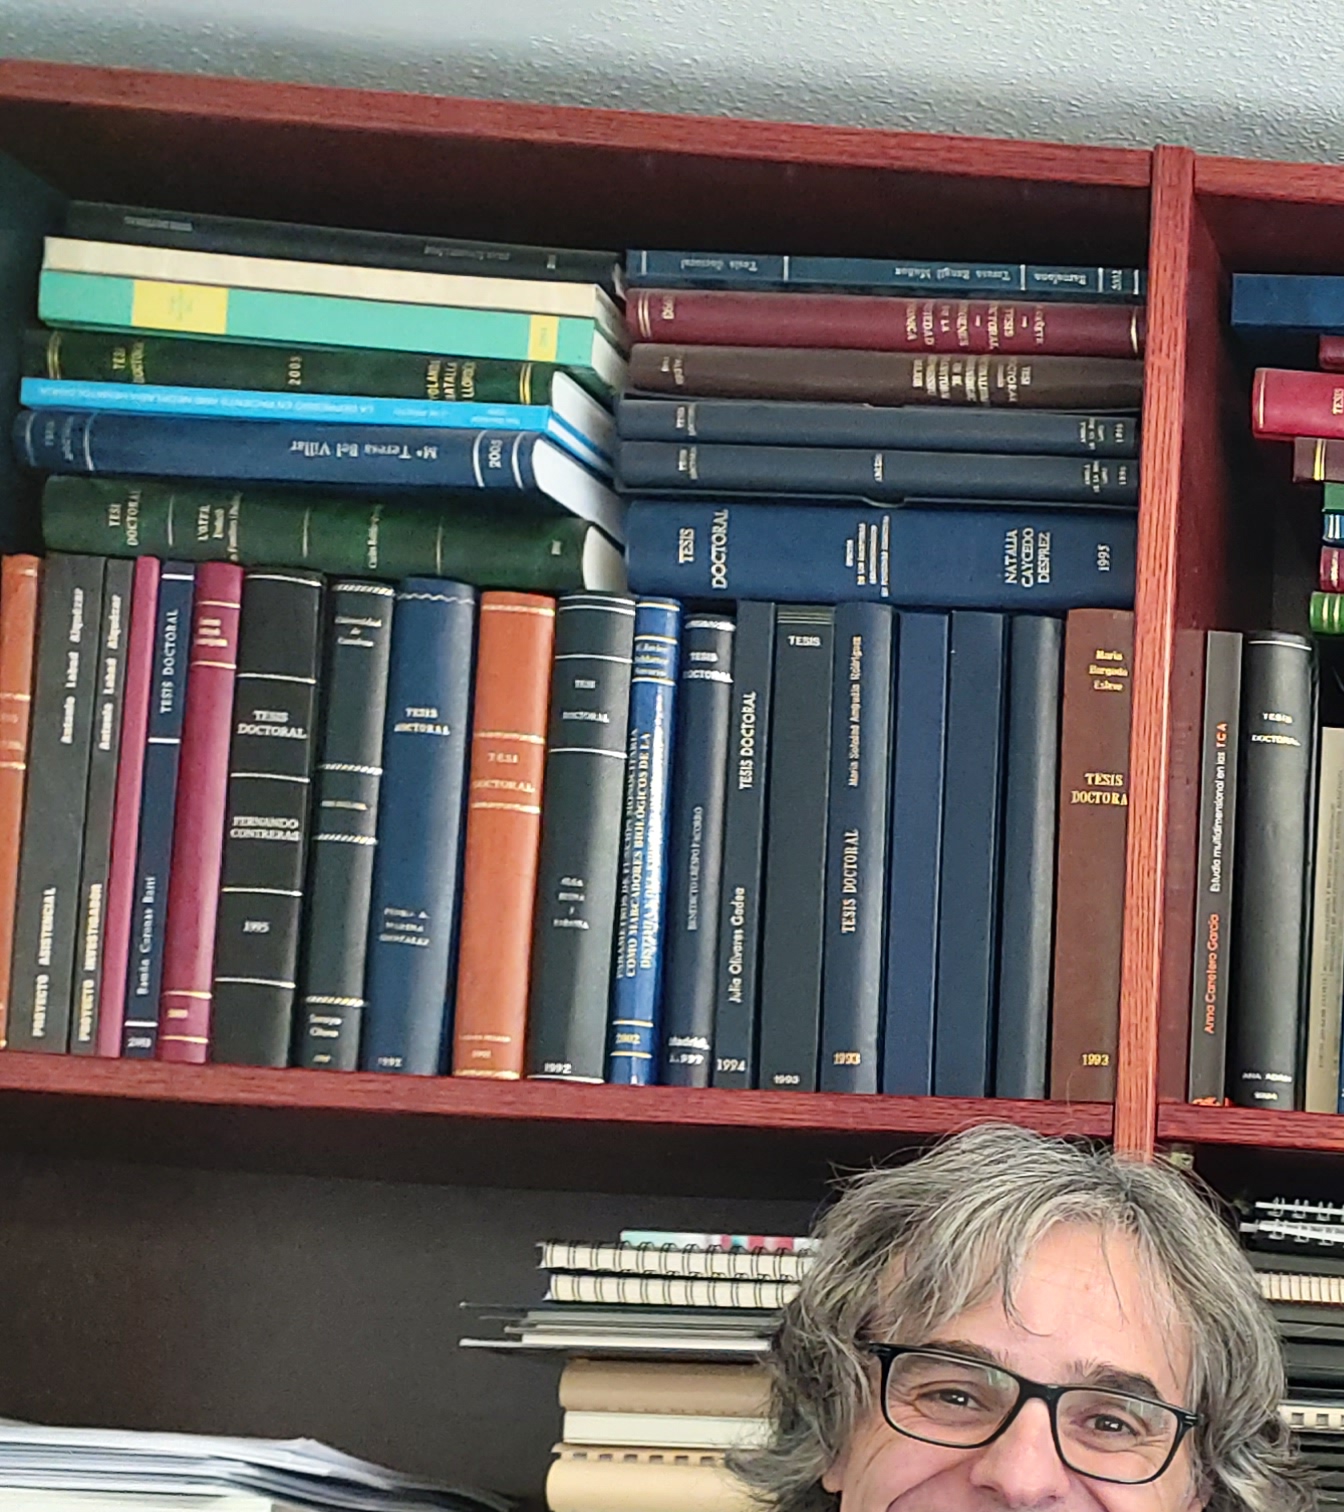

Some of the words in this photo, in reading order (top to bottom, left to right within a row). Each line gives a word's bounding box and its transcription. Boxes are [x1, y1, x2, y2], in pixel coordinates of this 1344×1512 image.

[1332, 388, 1344, 415] TESIS
[290, 440, 330, 457] Villar
[335, 442, 358, 458] Bel
[365, 443, 412, 460] Teresa
[679, 527, 695, 563] TESIS
[711, 509, 729, 589] DOCTORAL
[1005, 528, 1018, 584] NATALIA
[1020, 527, 1034, 588] CAYCEDO
[1037, 531, 1051, 584] DESPREZ
[162, 609, 179, 677] DOCTORAL
[787, 635, 821, 647] TESIS
[159, 681, 173, 714] TESIS
[237, 722, 307, 739] DOCTORAL
[252, 709, 289, 723] TESIS
[741, 691, 758, 757] DOCTORAL
[639, 732, 651, 750] LA
[638, 751, 650, 771] DE
[738, 761, 753, 791] TESIS
[1216, 766, 1226, 780] en
[1084, 772, 1124, 786] TESIS
[231, 815, 300, 829] FERNANDO
[633, 771, 649, 850] BIOLÓGICOS
[229, 828, 301, 842] CONTRERAS
[843, 829, 860, 894] DOCTORAL
[628, 851, 643, 937] MARCADORES
[841, 898, 857, 934] TESIS
[625, 938, 638, 978] COMO
[730, 922, 745, 973] Olivares
[728, 977, 743, 1004] Julia
[32, 974, 49, 1038] PROYECTO
[78, 979, 95, 1042] PROYECTO
[1204, 1005, 1216, 1035] Anna
[716, 1058, 746, 1073] 1994
[1081, 1053, 1110, 1067] 1993
